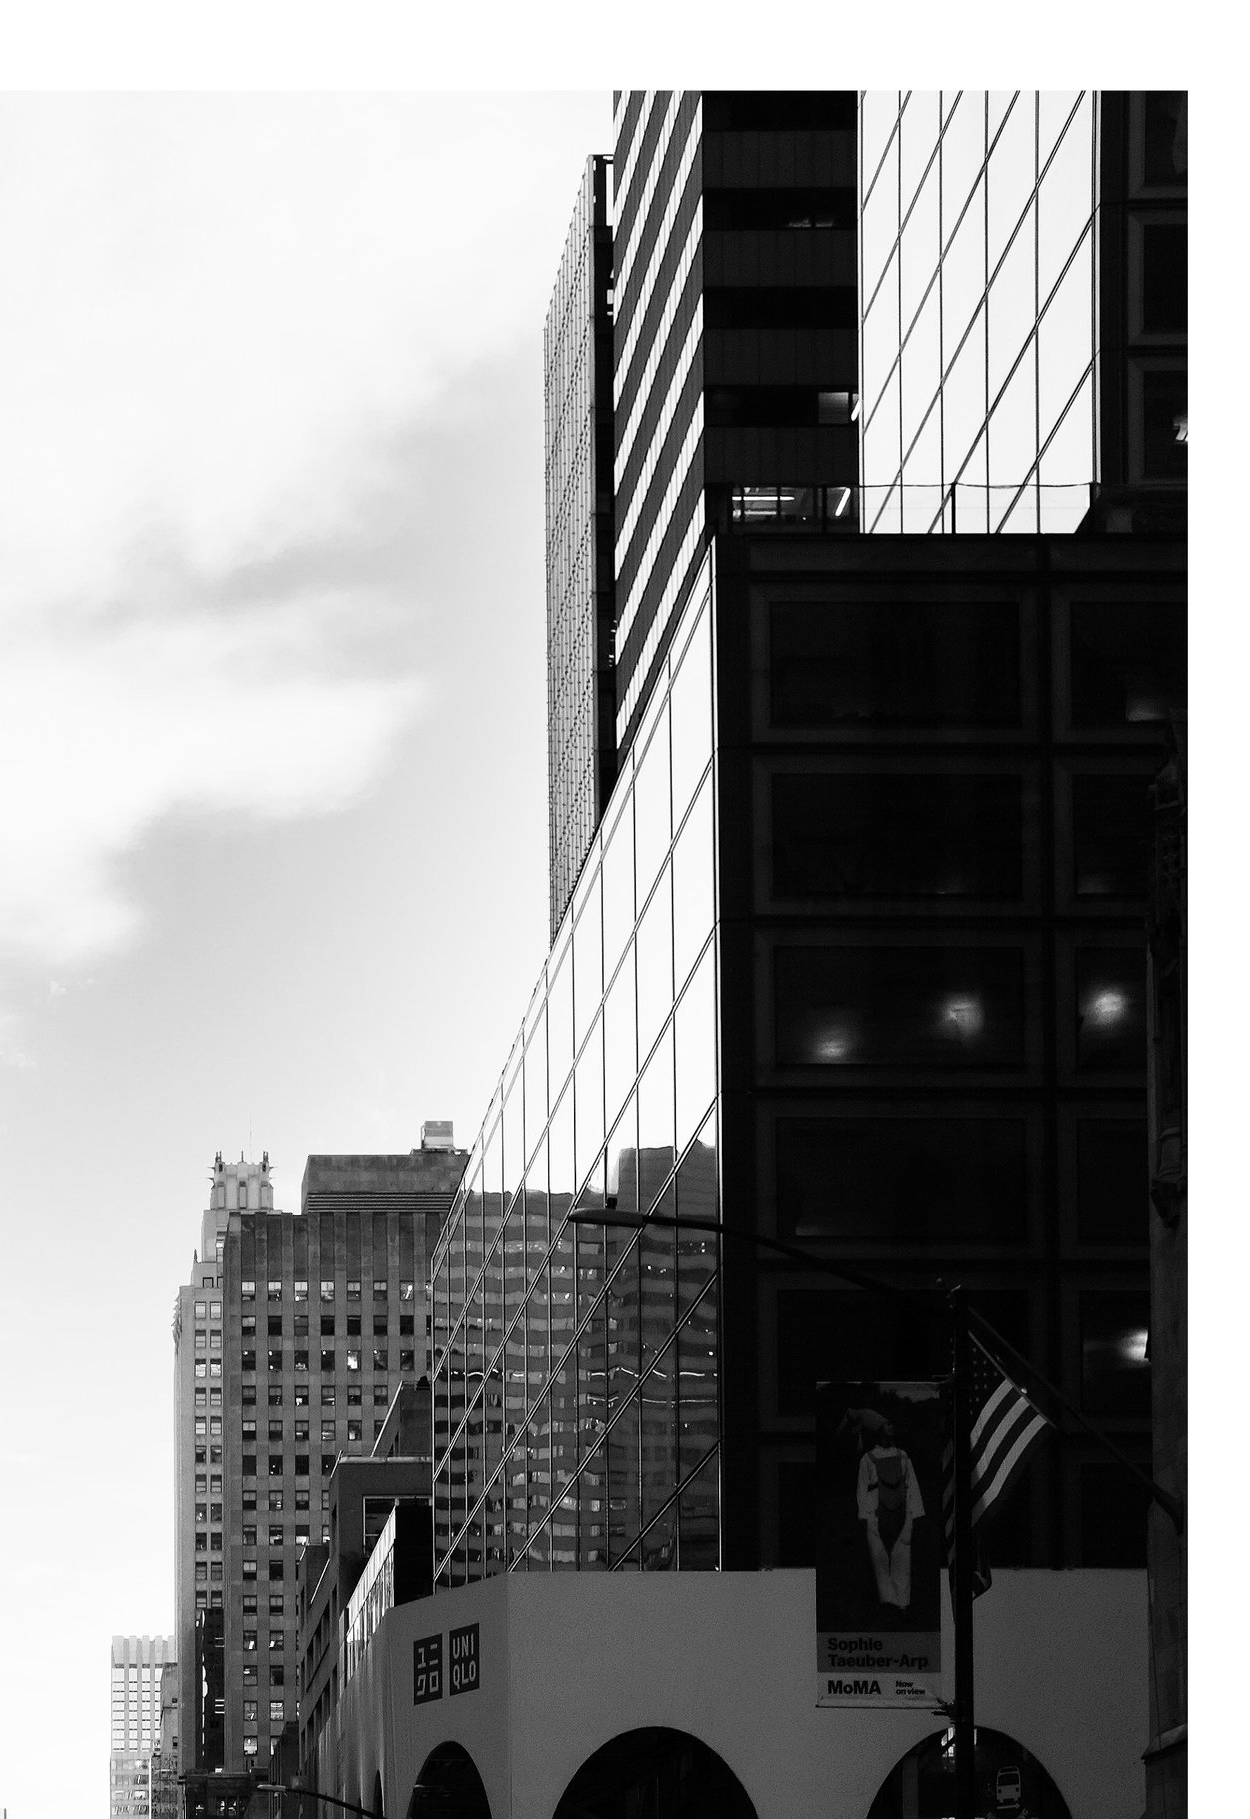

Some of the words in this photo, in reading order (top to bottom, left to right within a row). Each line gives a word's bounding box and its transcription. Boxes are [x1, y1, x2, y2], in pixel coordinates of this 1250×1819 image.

[417, 1643, 439, 1669] ユニ
[452, 1632, 474, 1660] UNI
[828, 1638, 883, 1653] Sophie
[828, 1654, 928, 1670] Taeuber-Arp
[416, 1671, 439, 1696] クロ
[452, 1660, 477, 1690] QLO
[828, 1680, 881, 1694] MoMA
